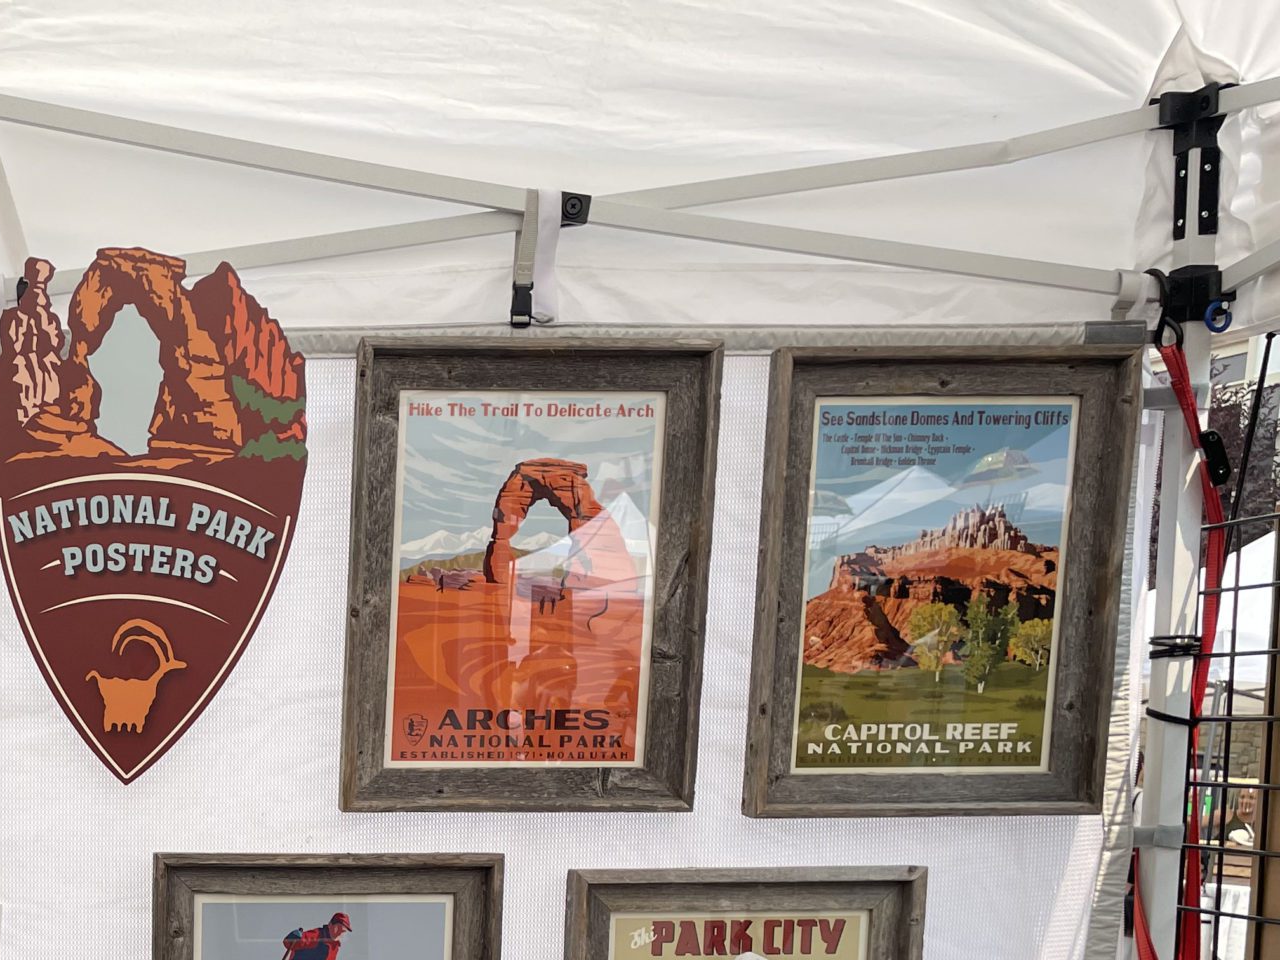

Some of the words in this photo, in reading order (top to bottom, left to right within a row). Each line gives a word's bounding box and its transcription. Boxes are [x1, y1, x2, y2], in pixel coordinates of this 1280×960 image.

[408, 403, 443, 417] Hike
[447, 403, 476, 417] The
[481, 403, 519, 417] Trail
[523, 403, 543, 417] To
[547, 403, 612, 418] Delicate
[616, 403, 655, 418] Arch
[821, 411, 843, 426] See
[910, 411, 948, 426] Domes
[952, 411, 973, 426] And
[977, 410, 1031, 429] Towering
[1034, 410, 1069, 426] Cliffs
[8, 494, 176, 544] NATIONAL
[186, 502, 275, 559] PARK
[61, 542, 218, 584] POSTERS
[438, 709, 611, 731] ARCHES
[429, 734, 551, 748] NATIONAL
[559, 734, 623, 748] PARK
[824, 723, 939, 741] CAPITOL
[945, 722, 1018, 740] REEF
[400, 751, 504, 759] ESTABLISHED
[546, 751, 585, 760] MOAB
[589, 751, 629, 760] UTAH
[807, 741, 950, 754] NATIONAL
[958, 741, 1033, 753] PARK
[629, 925, 658, 949] Ski
[651, 920, 753, 956] PARK
[762, 918, 847, 956] CITY
